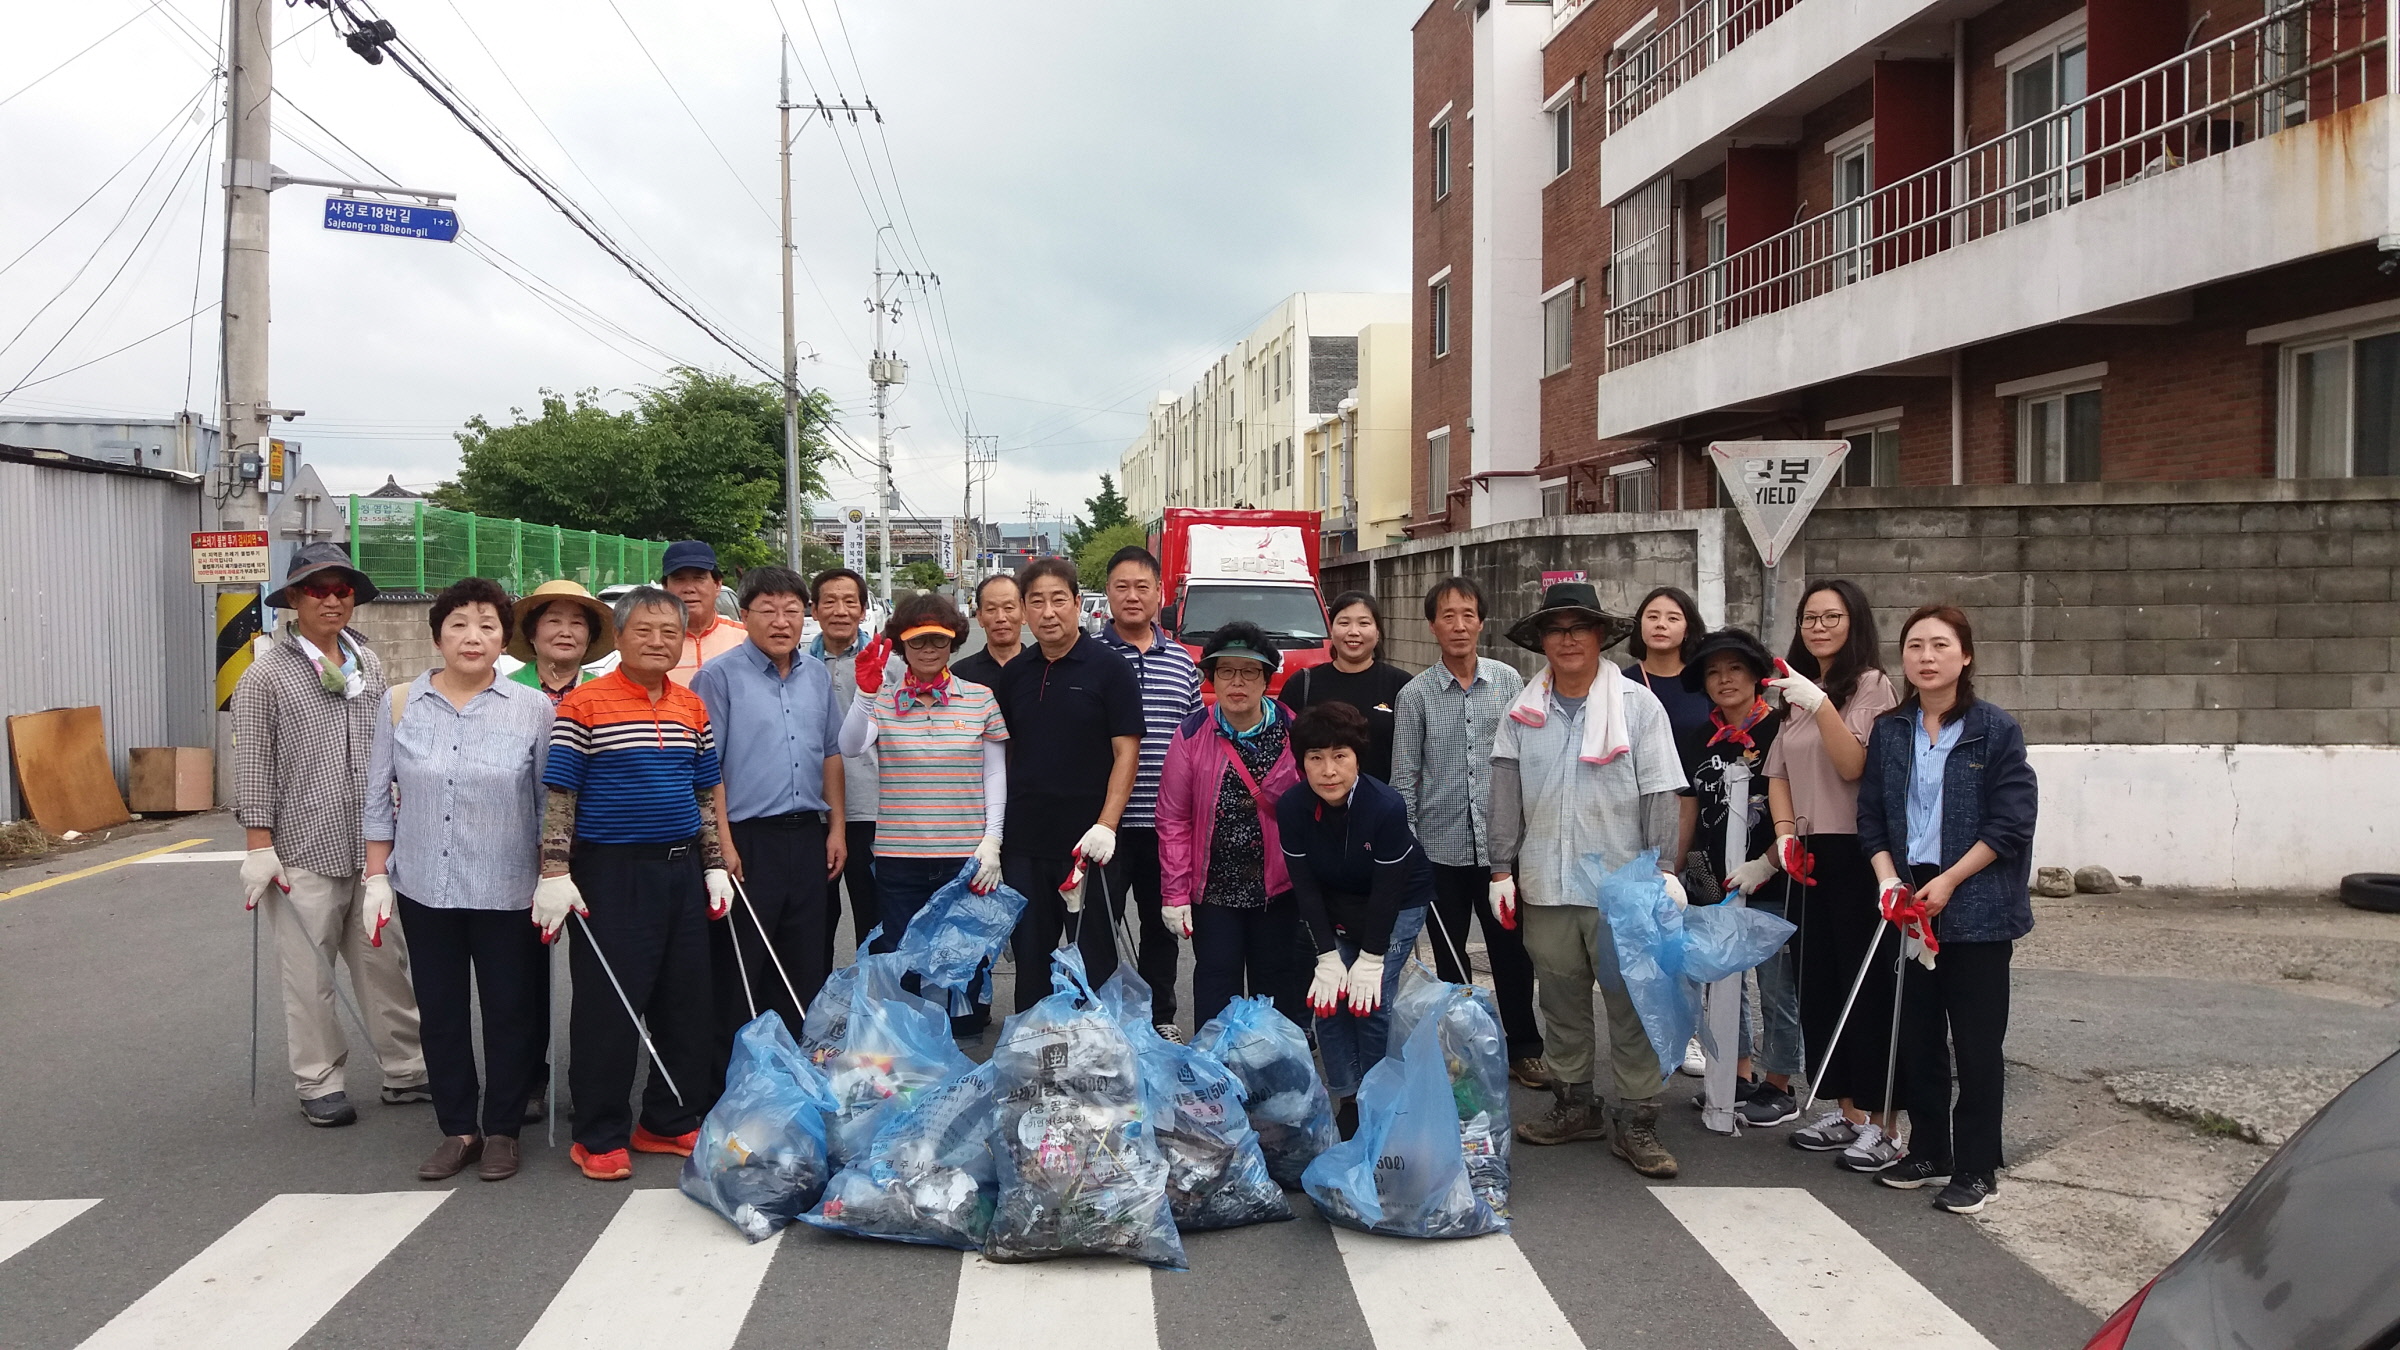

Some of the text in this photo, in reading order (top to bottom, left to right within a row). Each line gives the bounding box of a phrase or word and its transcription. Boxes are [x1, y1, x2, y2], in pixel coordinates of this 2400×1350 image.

[328, 202, 411, 224] 사정로18번길
[327, 218, 428, 238] Sajeong-ro 18beon-gil
[1755, 486, 1796, 505] YIELD
[202, 534, 216, 547] 쓰레기
[217, 534, 226, 548] 불법
[227, 534, 237, 547] 투기
